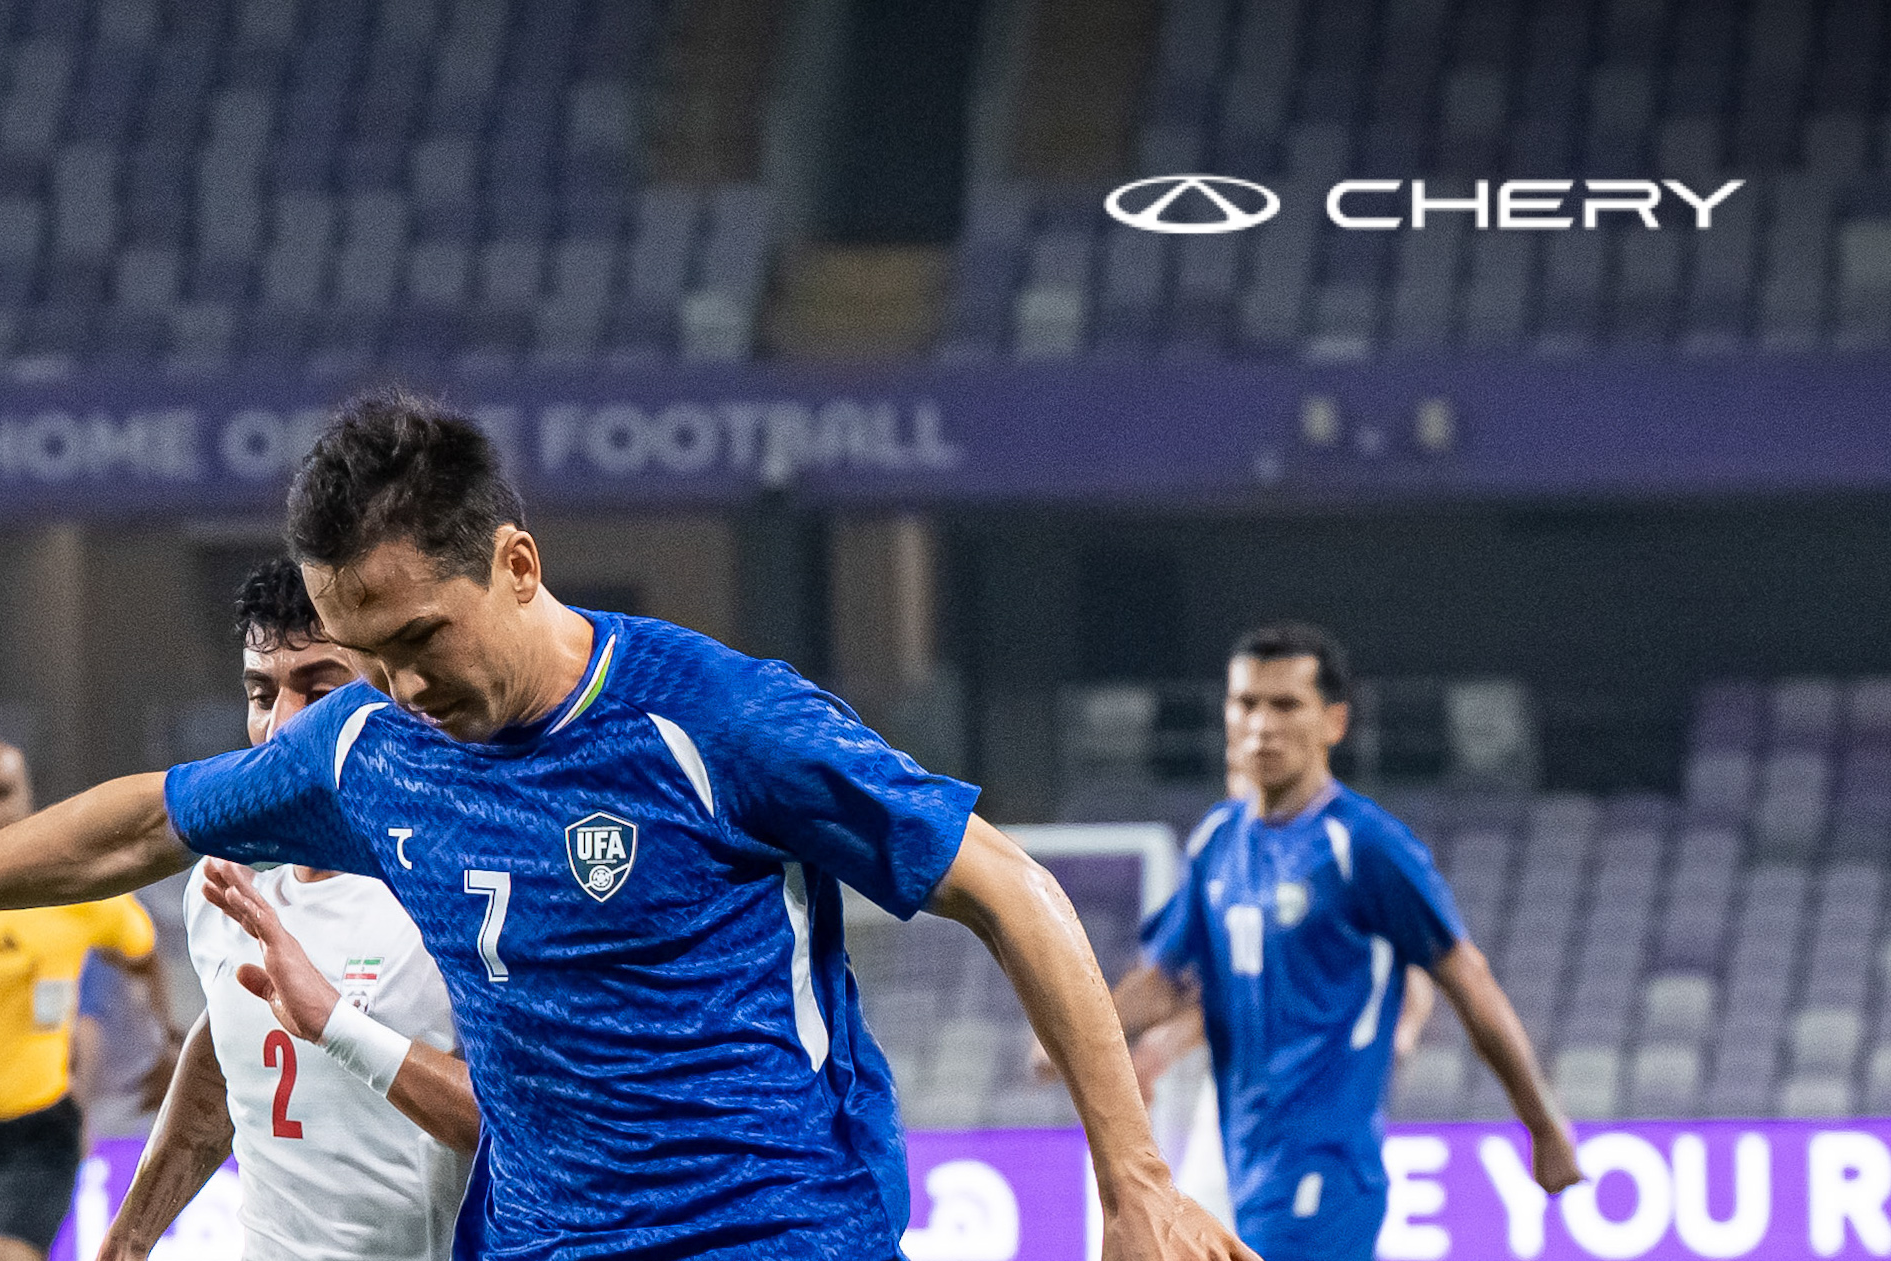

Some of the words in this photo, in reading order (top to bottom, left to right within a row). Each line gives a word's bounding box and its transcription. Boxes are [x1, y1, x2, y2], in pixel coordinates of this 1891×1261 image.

[540, 401, 964, 474] FOOTBALL
[576, 830, 626, 860] UFA
[463, 869, 511, 983] 7
[263, 1029, 304, 1140] 2
[1478, 1132, 1772, 1261] YOU
